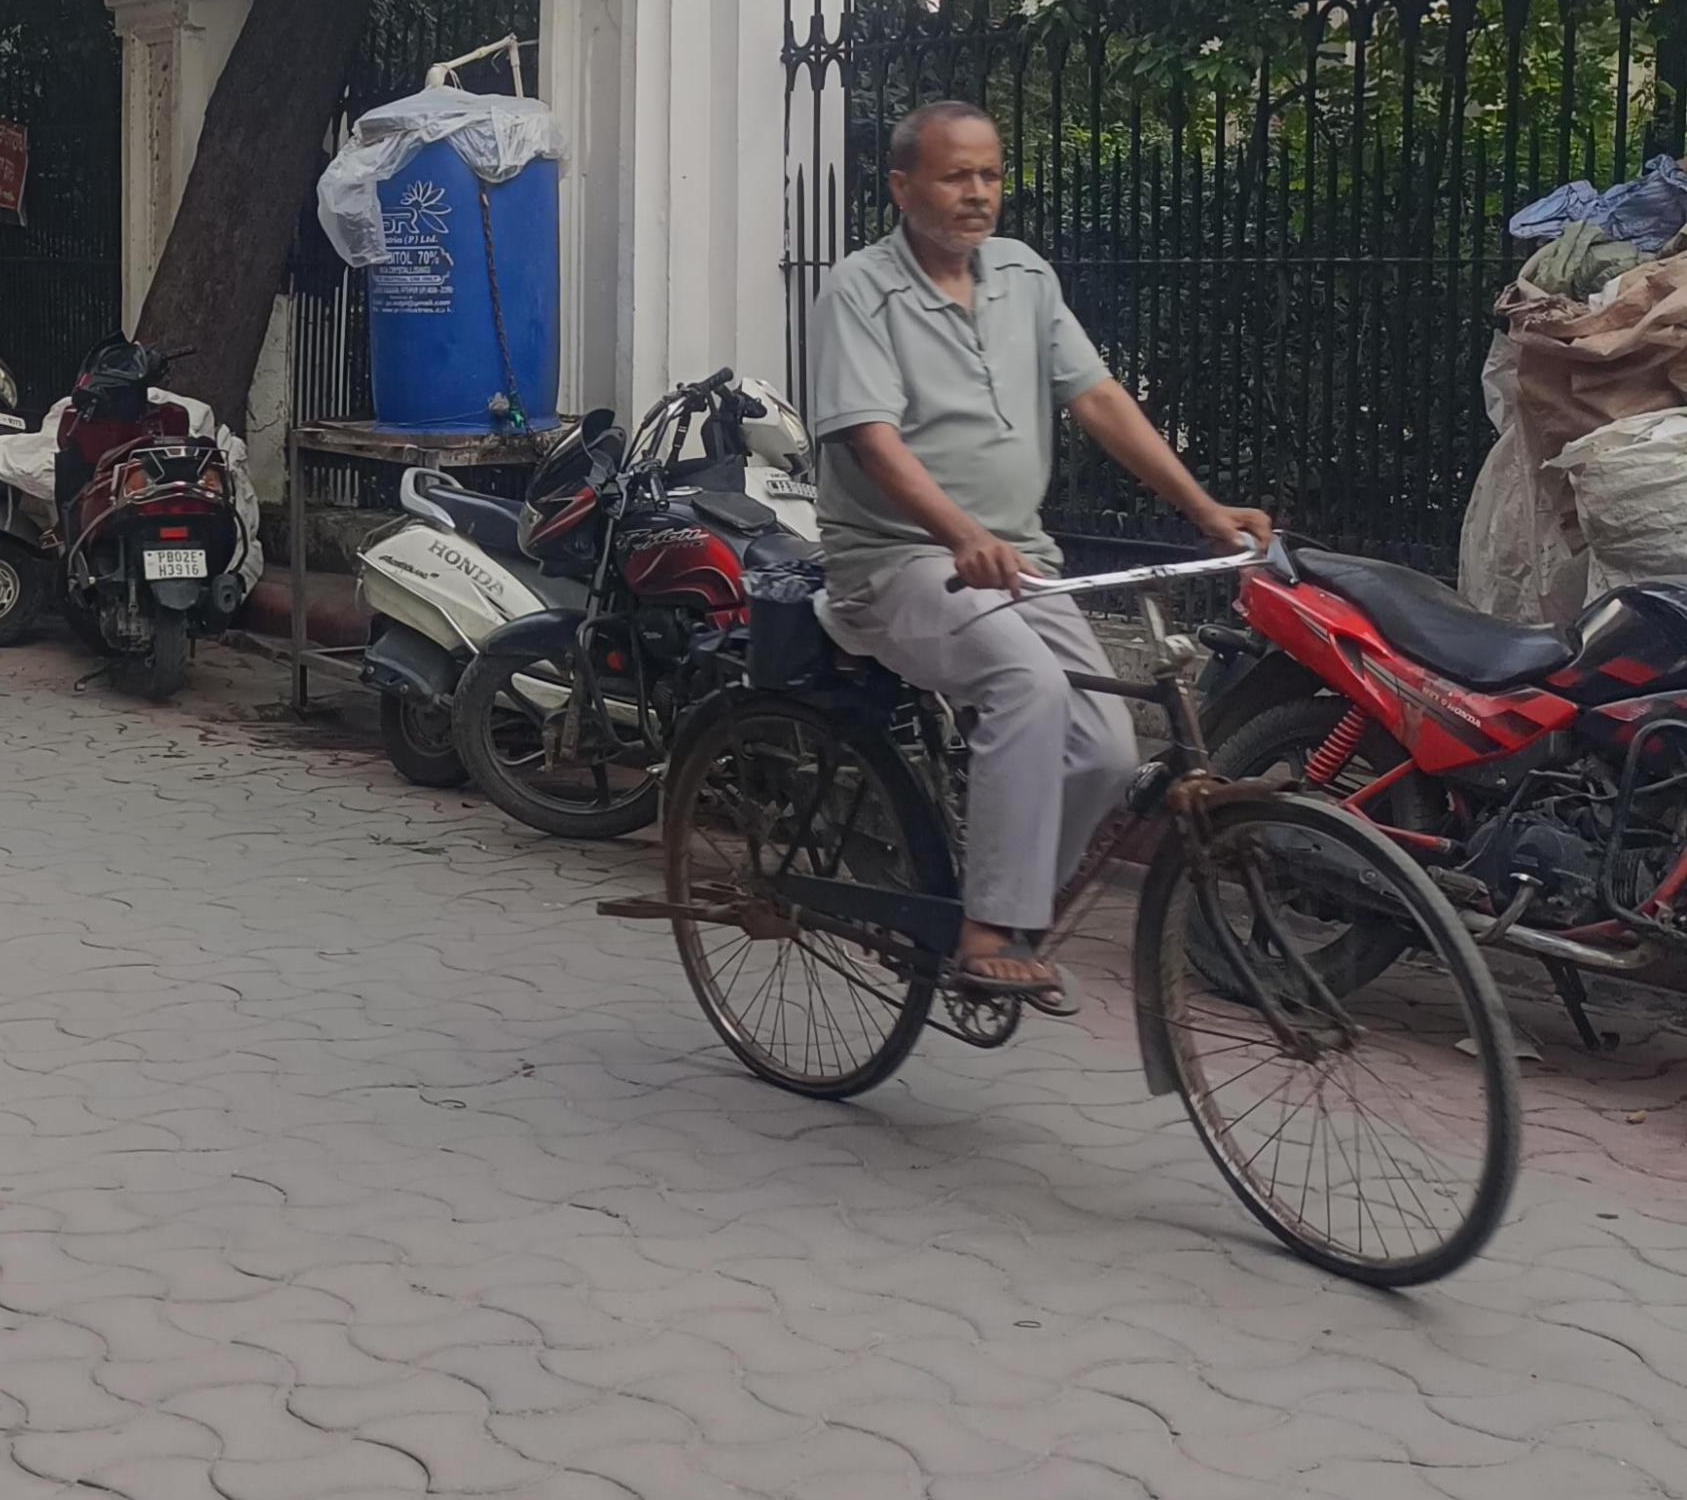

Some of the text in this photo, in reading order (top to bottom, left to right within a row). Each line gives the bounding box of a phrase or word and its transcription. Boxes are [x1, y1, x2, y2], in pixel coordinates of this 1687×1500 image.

[418, 250, 439, 265] 70%
[158, 551, 199, 564] PB02E
[158, 563, 200, 577] H3916
[428, 540, 504, 597] HONDA
